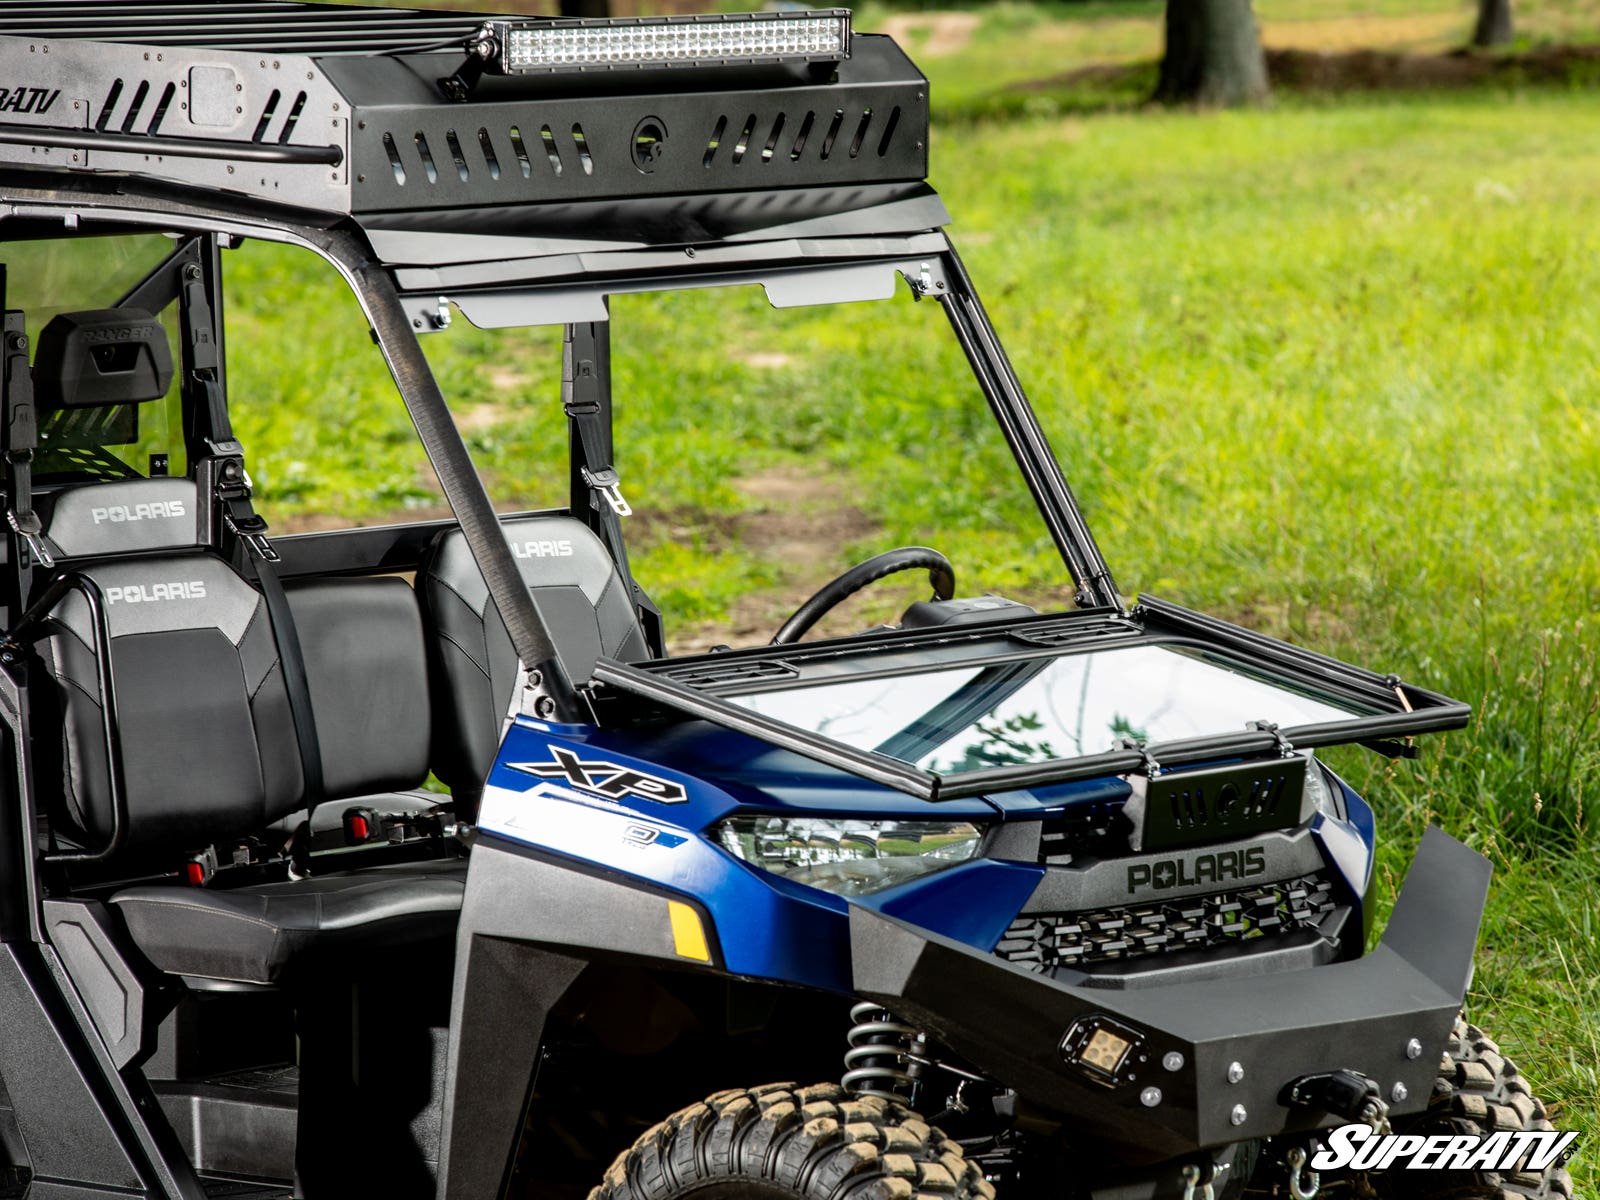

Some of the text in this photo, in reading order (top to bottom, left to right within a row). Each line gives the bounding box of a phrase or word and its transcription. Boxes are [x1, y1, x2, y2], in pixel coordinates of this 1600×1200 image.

[83, 326, 153, 341] RANGER
[91, 500, 185, 524] POLARIS
[509, 540, 573, 559] LARIS
[105, 581, 206, 605] POLARIS
[505, 744, 690, 804] XP
[1127, 846, 1265, 894] POLARIS
